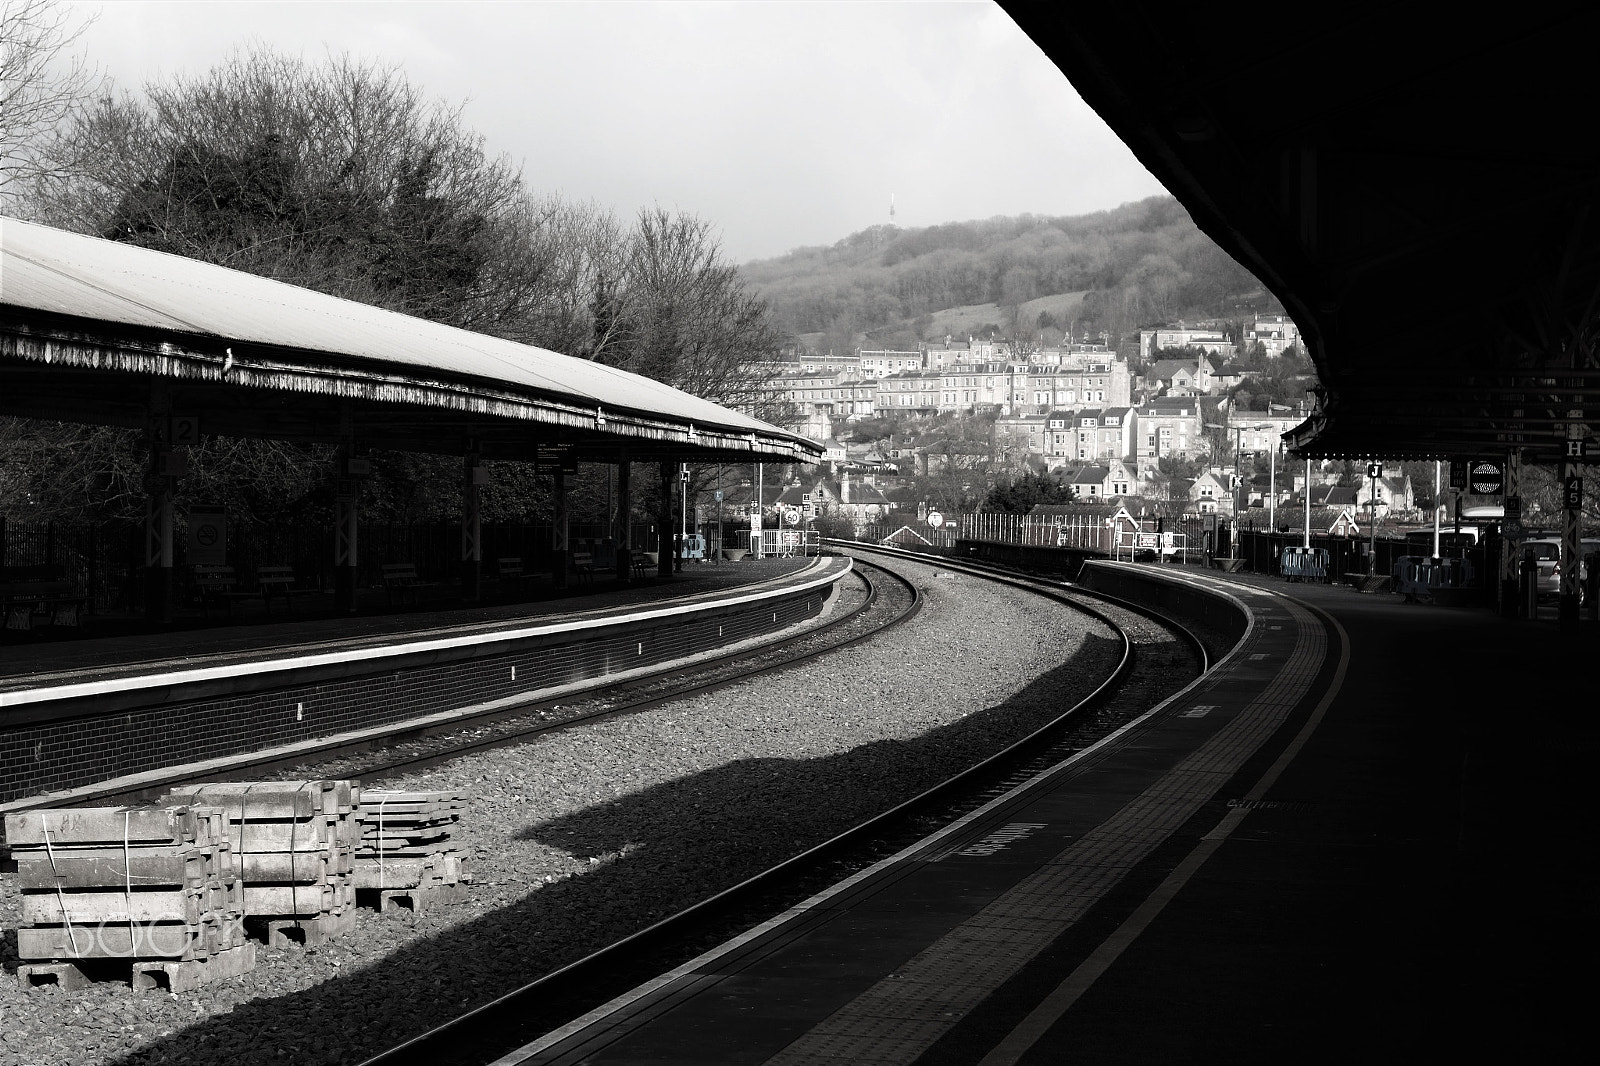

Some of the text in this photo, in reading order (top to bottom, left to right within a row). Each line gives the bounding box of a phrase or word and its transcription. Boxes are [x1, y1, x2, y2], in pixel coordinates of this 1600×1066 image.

[178, 420, 191, 440] 2
[1566, 441, 1583, 457] H
[1371, 465, 1379, 477] J
[1569, 479, 1579, 491] 4
[1569, 492, 1579, 504] 5
